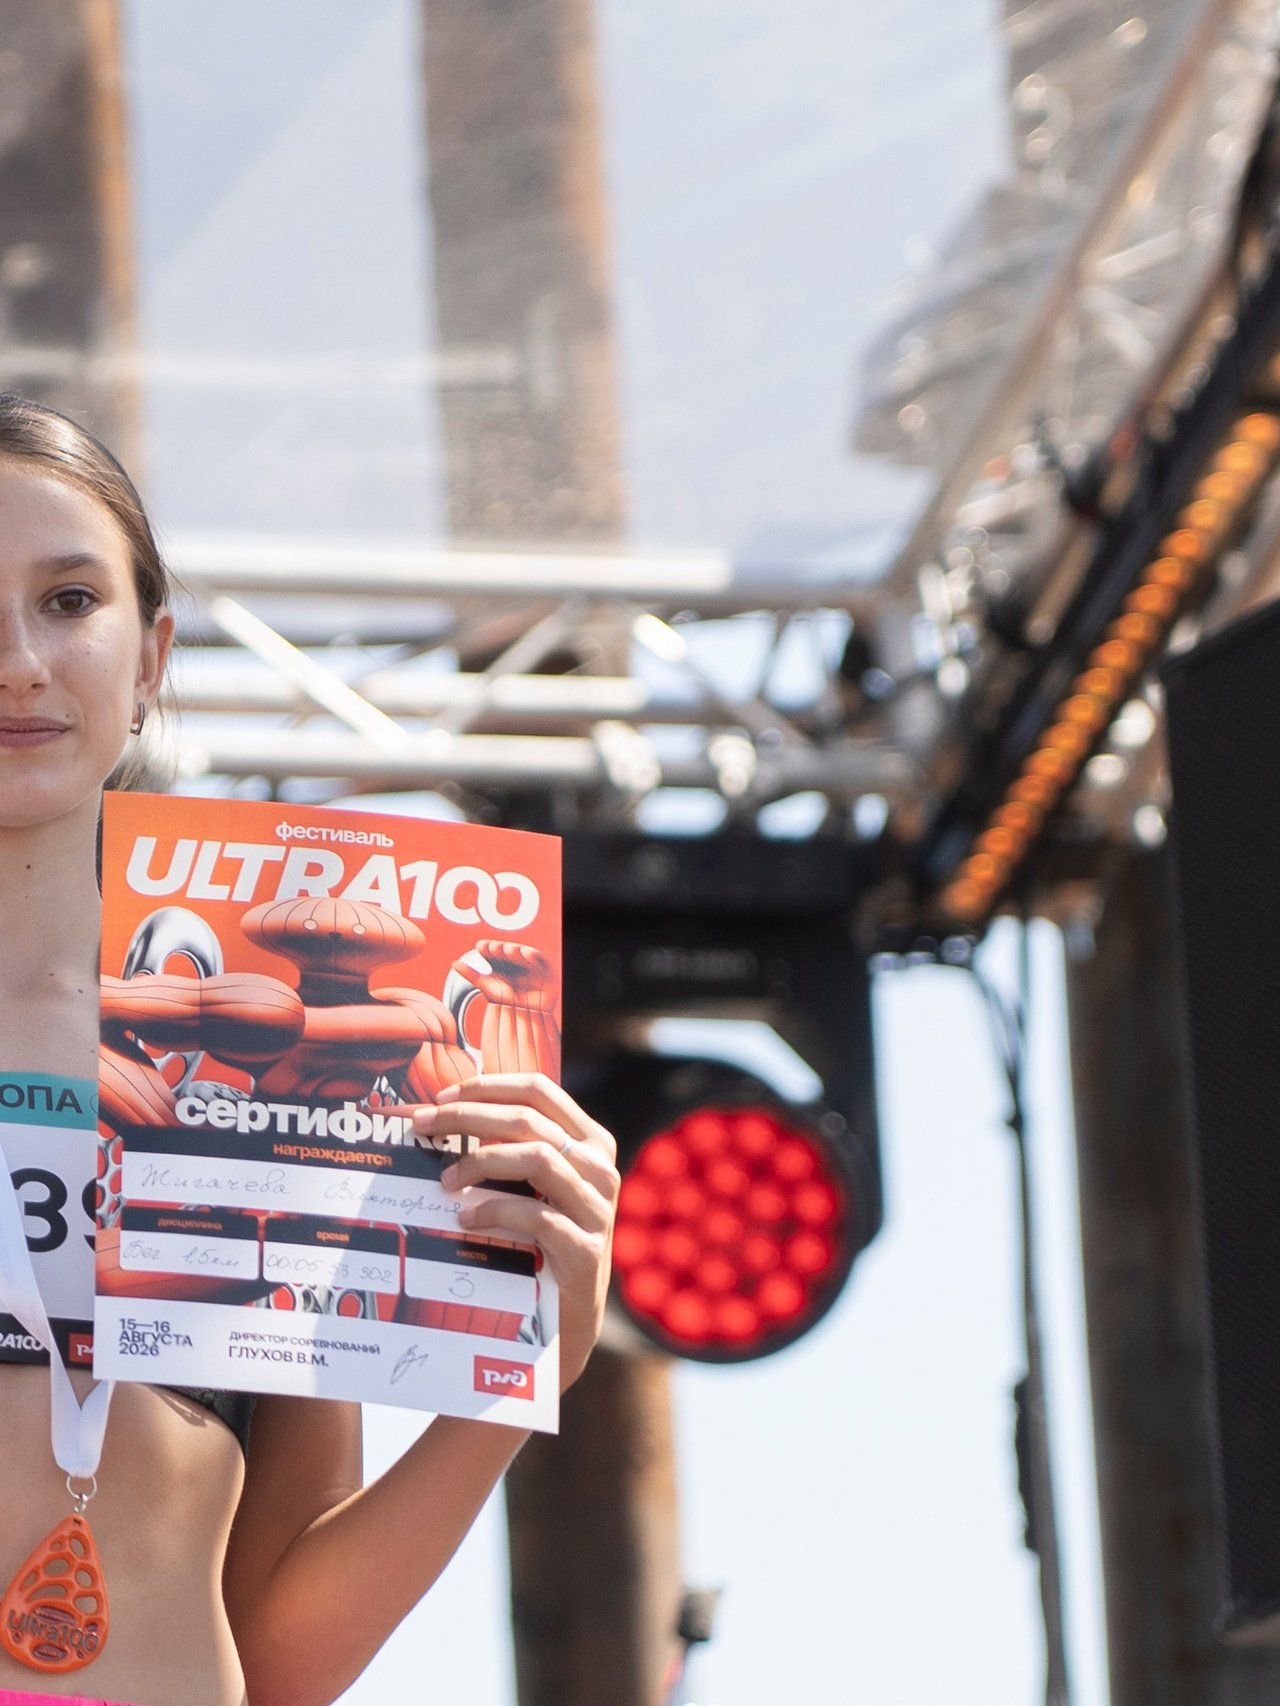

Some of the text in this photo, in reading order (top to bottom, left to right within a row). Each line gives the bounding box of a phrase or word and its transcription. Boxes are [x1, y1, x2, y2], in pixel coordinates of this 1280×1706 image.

[275, 822, 394, 848] фестиваль
[126, 836, 540, 930] ULTRA100
[273, 1142, 393, 1167] награждается
[316, 1230, 350, 1242] время
[448, 1271, 476, 1299] 3
[120, 1330, 193, 1347] АВГУСТА
[120, 1342, 160, 1356] 2026
[229, 1331, 380, 1355] ДИРЕКТОР СОРЕВНОВАНИЙ
[228, 1345, 329, 1367] ГЛУХОВ В.М.
[8, 1609, 100, 1653] Ultra100
